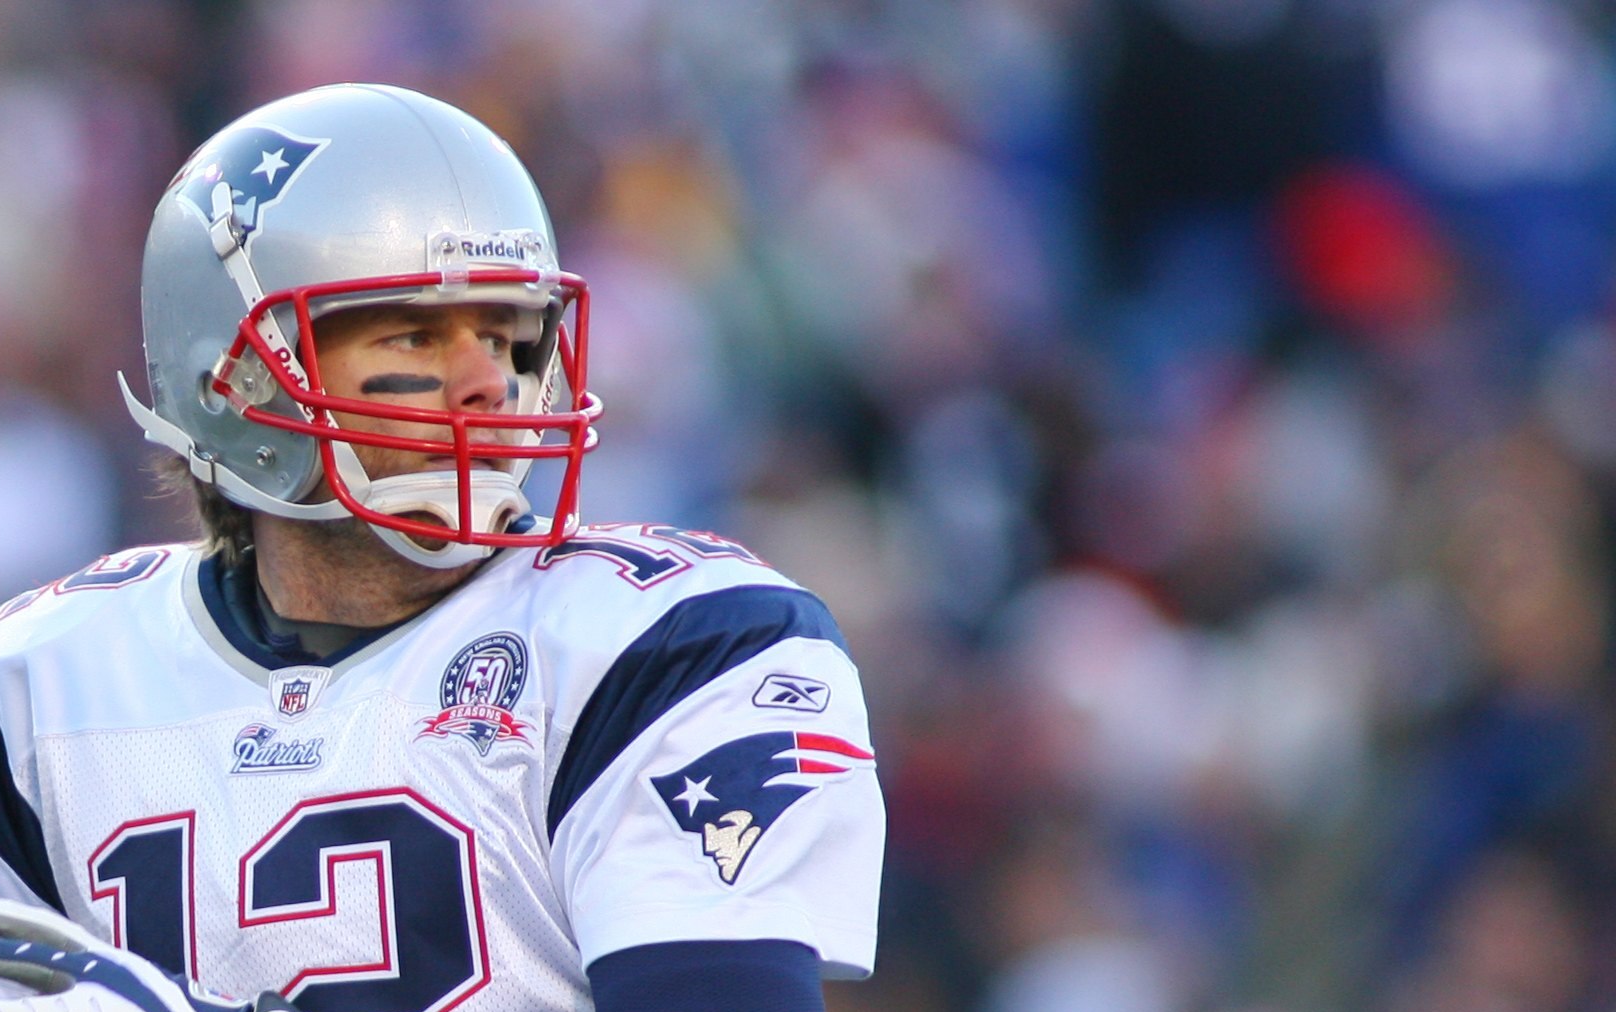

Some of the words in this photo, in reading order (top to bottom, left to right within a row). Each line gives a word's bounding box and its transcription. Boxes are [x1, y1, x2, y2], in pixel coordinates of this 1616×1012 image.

[460, 239, 526, 260] Riddell
[459, 656, 509, 704] 50
[281, 693, 306, 712] NFL
[449, 707, 502, 721] SEASONS
[232, 738, 323, 773] Patriots
